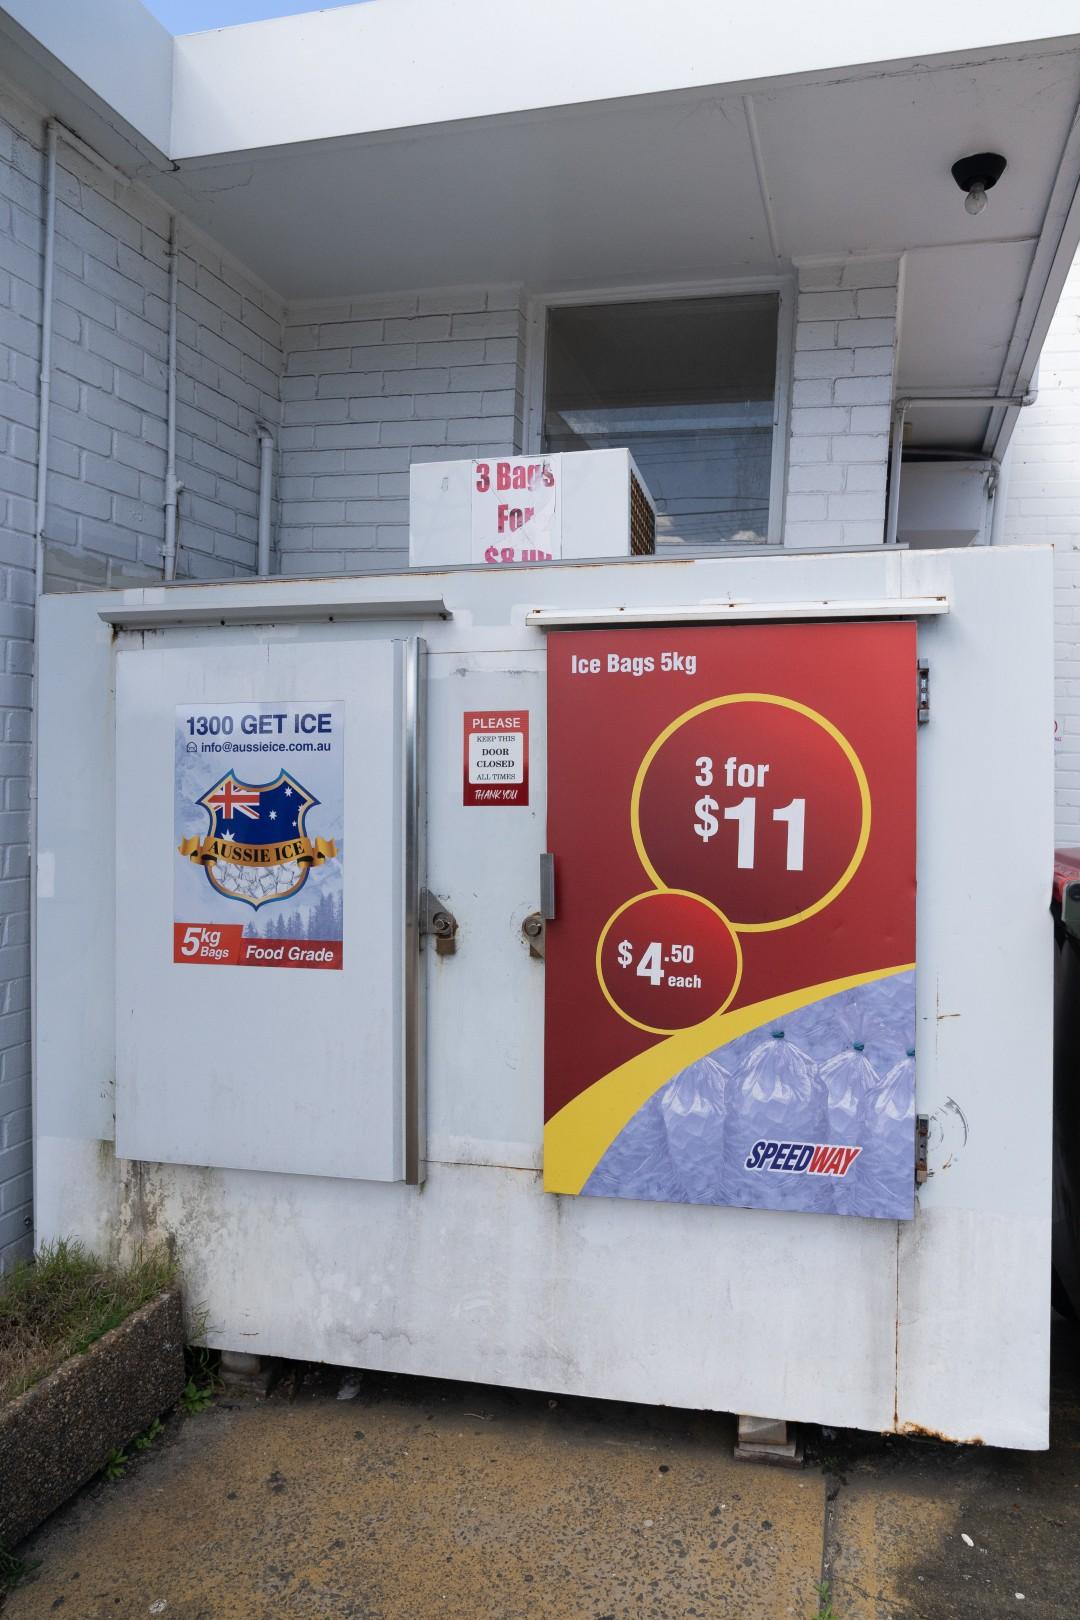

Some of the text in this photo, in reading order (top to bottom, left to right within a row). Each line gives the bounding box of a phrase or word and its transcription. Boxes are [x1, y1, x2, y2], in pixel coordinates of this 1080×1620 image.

[476, 463, 490, 493] 3
[571, 652, 697, 677] Ice Bags 5kg
[186, 713, 332, 736] 1300 GET ICE
[472, 717, 521, 729] PLEASE
[476, 735, 497, 743] KEEP
[201, 741, 331, 754] info@aussieice.com.au
[481, 748, 510, 756] DOOR
[476, 760, 515, 768] CLOSED
[695, 756, 769, 788] 3 for
[474, 789, 519, 800] THANK YOU
[208, 840, 305, 863] AUSSIE ICE
[200, 946, 229, 960] Bags
[246, 945, 334, 962] Food Grade
[668, 974, 702, 989] each
[745, 1140, 862, 1176] SPEEDWAY
